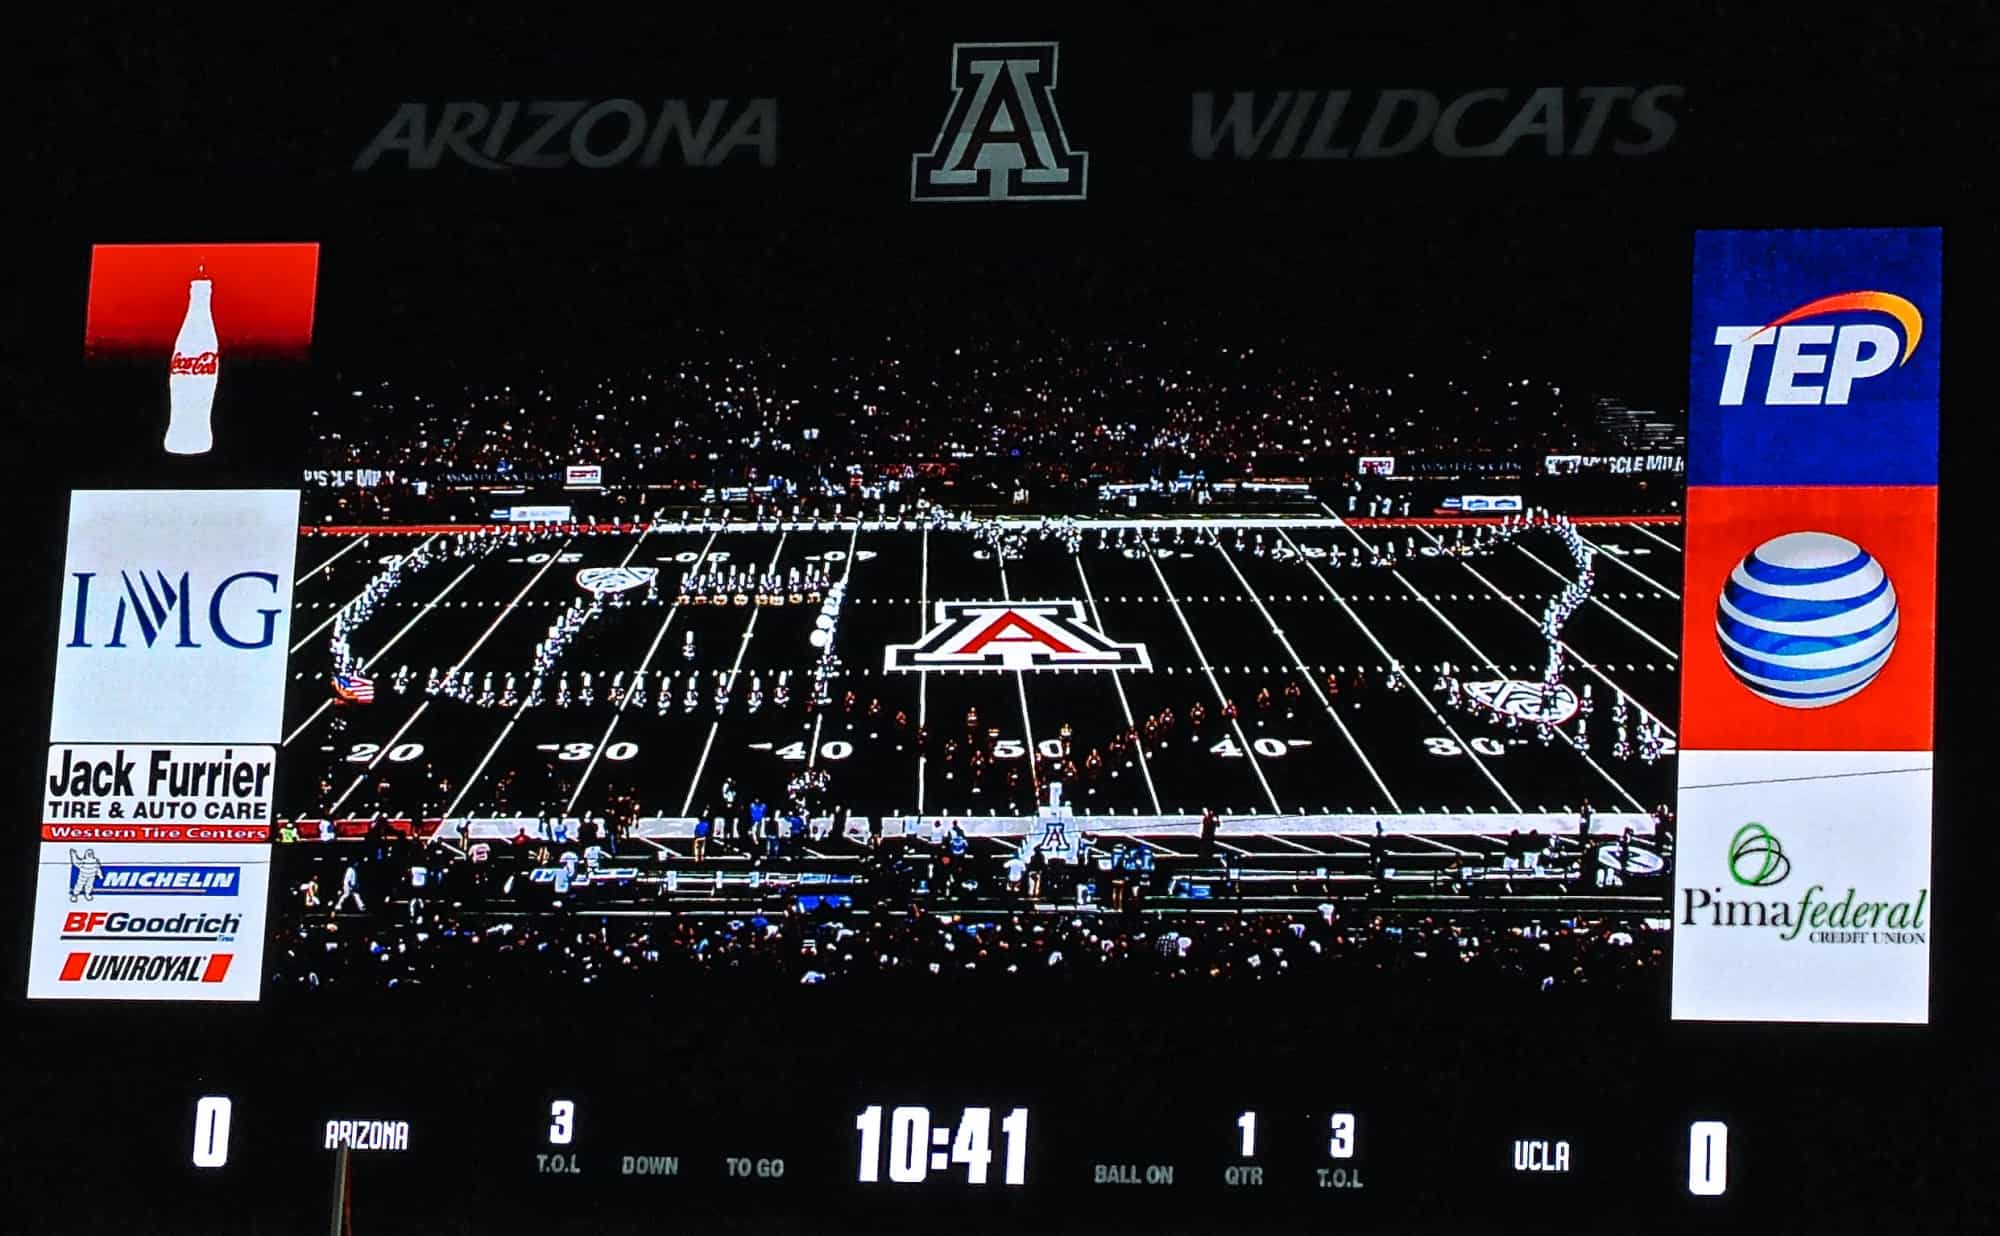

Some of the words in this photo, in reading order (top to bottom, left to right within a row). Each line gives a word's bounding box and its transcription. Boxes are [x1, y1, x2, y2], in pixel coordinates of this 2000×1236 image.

[353, 98, 779, 170] ARIZONA
[911, 42, 1089, 201] A
[1190, 84, 1686, 160] WILDCATS
[1713, 323, 1900, 406] TEP
[65, 569, 282, 650] IMG
[345, 743, 425, 762] 20
[557, 742, 639, 761] 30
[775, 740, 854, 760] 40
[1209, 734, 1288, 758] 40
[49, 749, 136, 798] Jack
[148, 748, 271, 798] Furrier
[48, 801, 101, 819] TIRE
[107, 801, 125, 819] &
[132, 801, 197, 820] AUTO
[204, 802, 268, 820] CARE
[51, 827, 137, 840] Western
[140, 827, 180, 839] Tire
[186, 828, 267, 841] Centers
[101, 871, 235, 888] MICHELIN
[62, 912, 240, 933] BFGoodrich
[1808, 931, 1870, 945] CREDIT
[1873, 931, 1927, 945] UNION
[85, 955, 204, 981] UNIROYAL
[193, 1096, 232, 1167] 0
[324, 1120, 409, 1150] ARIZONA
[549, 1100, 574, 1144] 3
[1238, 1111, 1256, 1157] 1
[1330, 1113, 1355, 1158] 3
[856, 1105, 1029, 1185] 10:41
[1514, 1140, 1570, 1171] UCLA
[1689, 1121, 1728, 1195] 0
[621, 1156, 679, 1176] DOWN
[726, 1157, 752, 1177] TO
[757, 1159, 785, 1178] GO
[1094, 1164, 1142, 1184] BALL
[1146, 1165, 1174, 1185] ON
[1224, 1166, 1263, 1186] QTR
